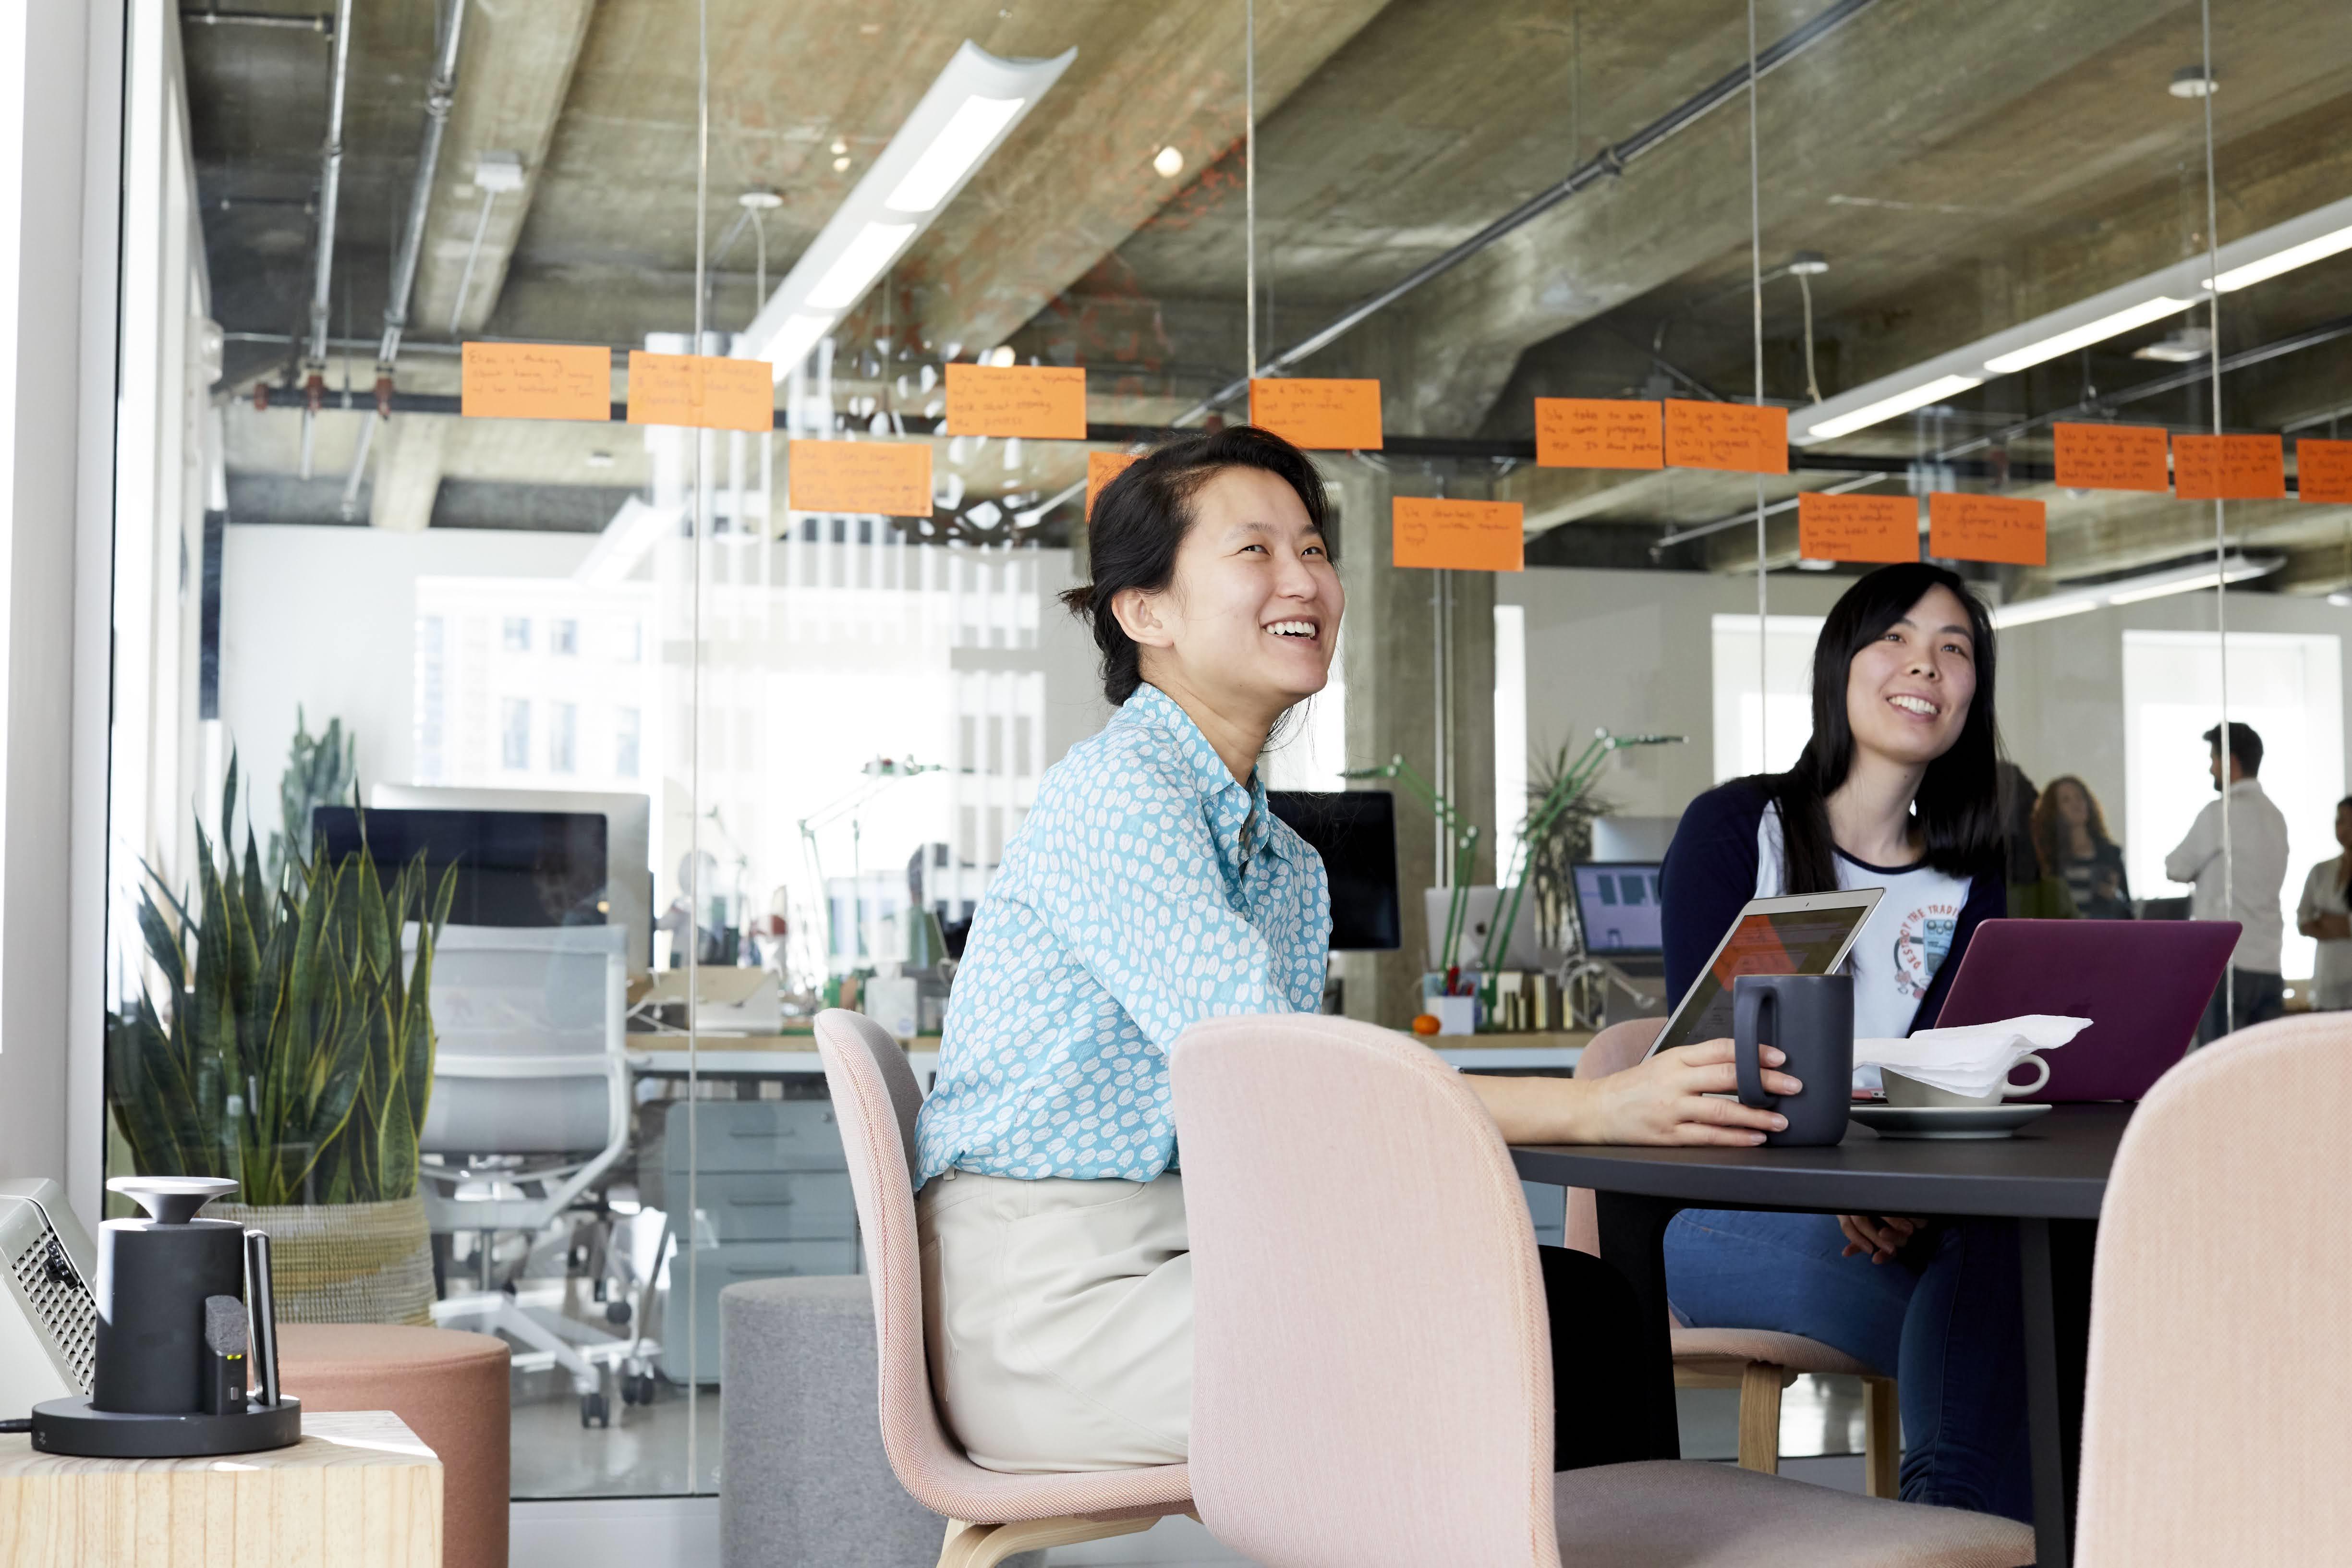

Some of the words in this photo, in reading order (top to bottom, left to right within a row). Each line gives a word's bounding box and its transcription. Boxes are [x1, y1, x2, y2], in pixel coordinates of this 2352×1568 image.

[1907, 908, 1926, 923] THE
[1928, 904, 1959, 916] TRADI
[1900, 922, 1921, 969] DESTROY
